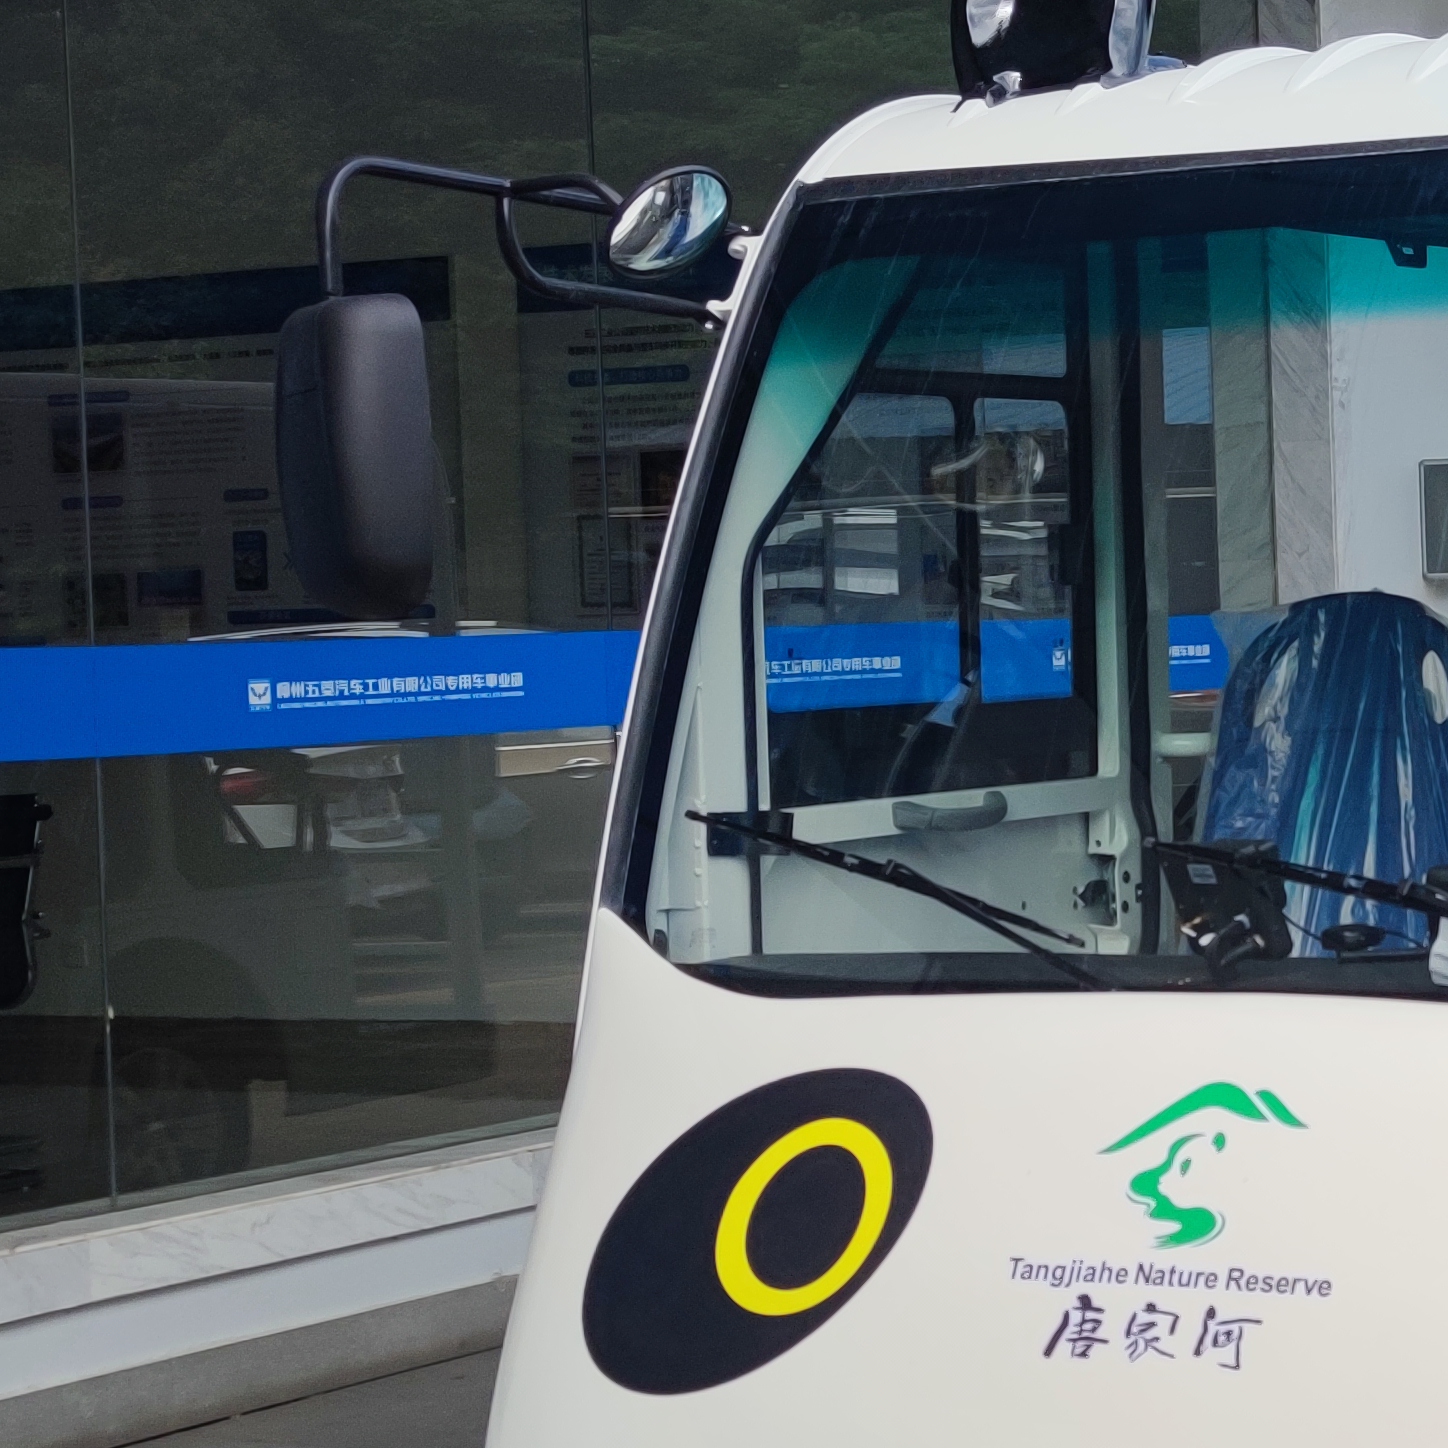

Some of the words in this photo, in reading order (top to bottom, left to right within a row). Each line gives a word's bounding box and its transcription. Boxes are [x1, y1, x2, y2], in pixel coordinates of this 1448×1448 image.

[1010, 1256, 1128, 1287] Tangjiahe
[1133, 1262, 1218, 1290] Nature
[1225, 1267, 1333, 1297] Reserve
[1043, 1294, 1263, 1370] 唐家河
